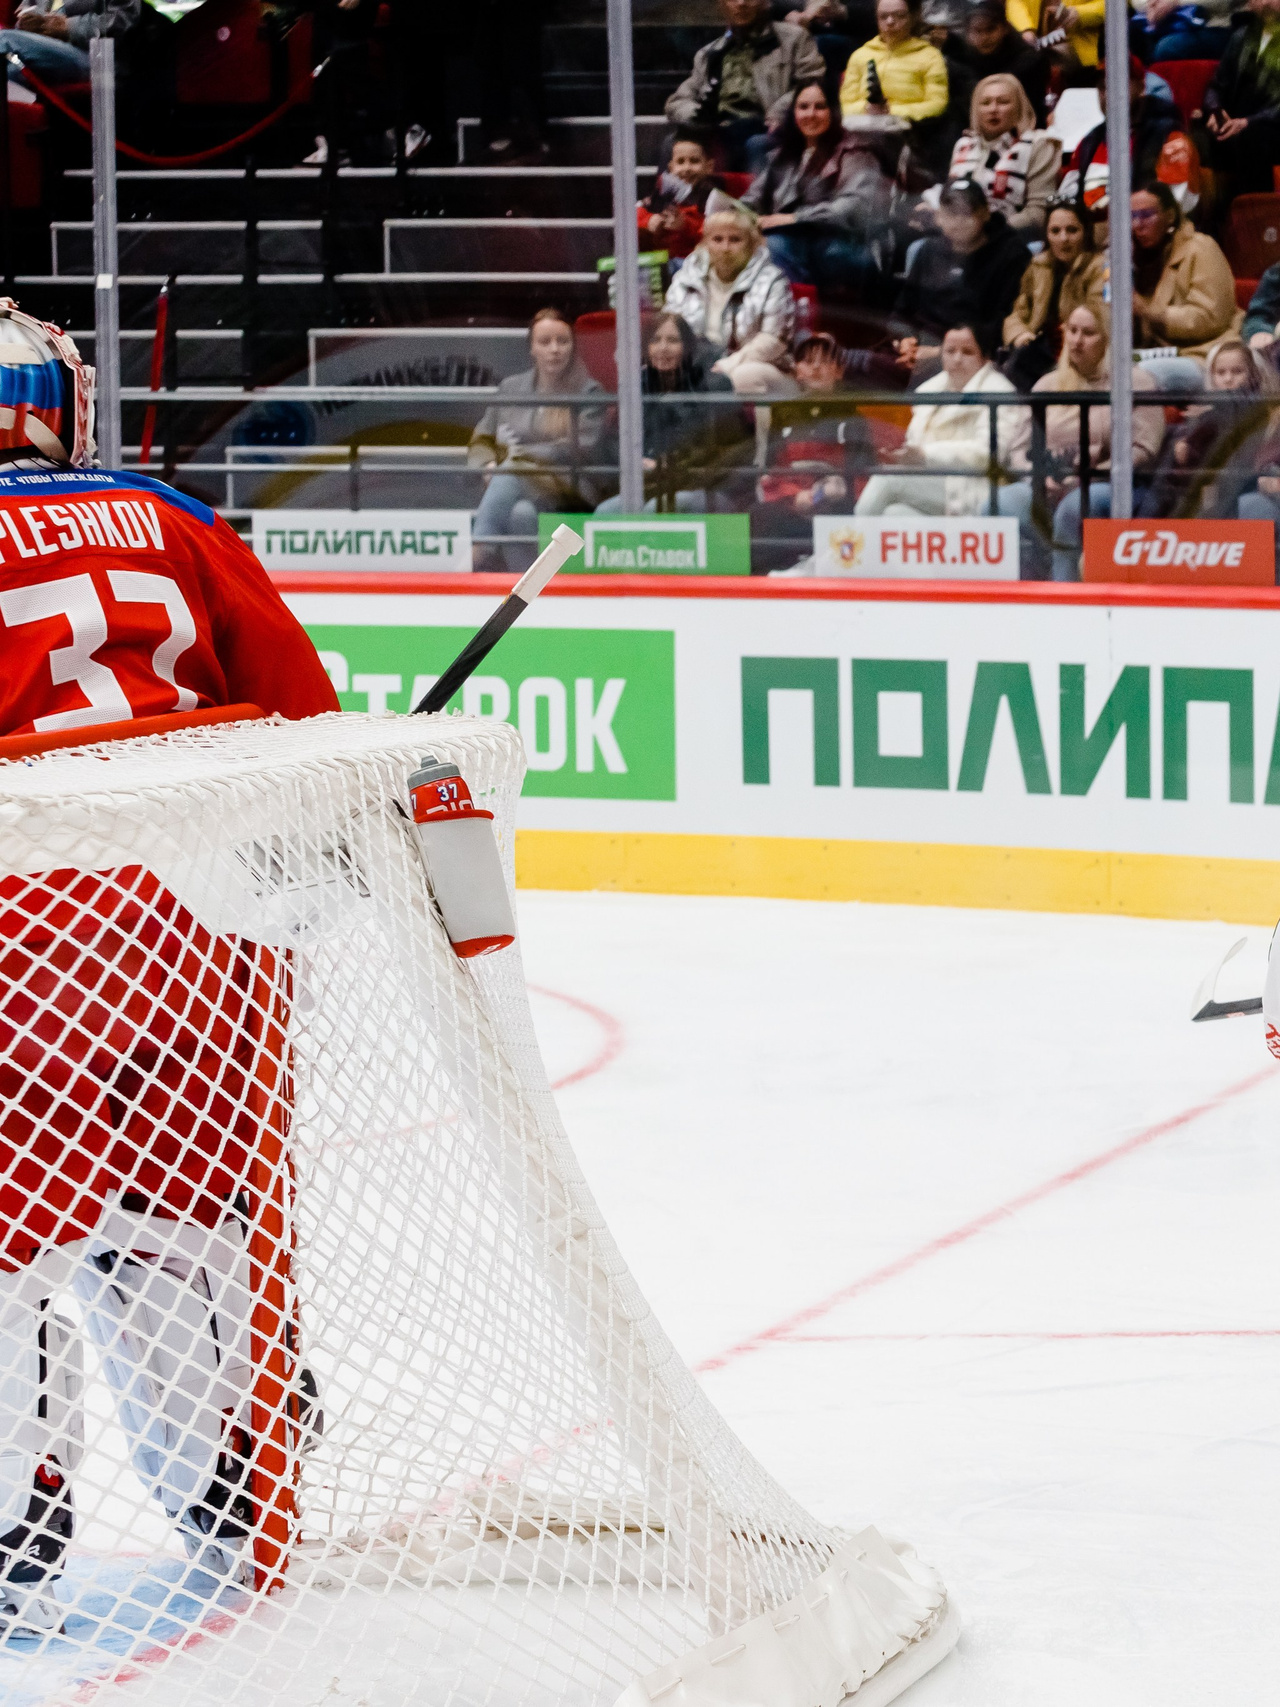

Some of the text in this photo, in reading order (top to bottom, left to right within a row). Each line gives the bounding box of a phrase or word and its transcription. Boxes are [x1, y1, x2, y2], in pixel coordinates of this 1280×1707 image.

[265, 529, 459, 555] ПОЛИПЛАСТ
[881, 531, 1004, 565] FHR.RU
[0, 570, 198, 733] 37
[437, 783, 458, 802] 37
